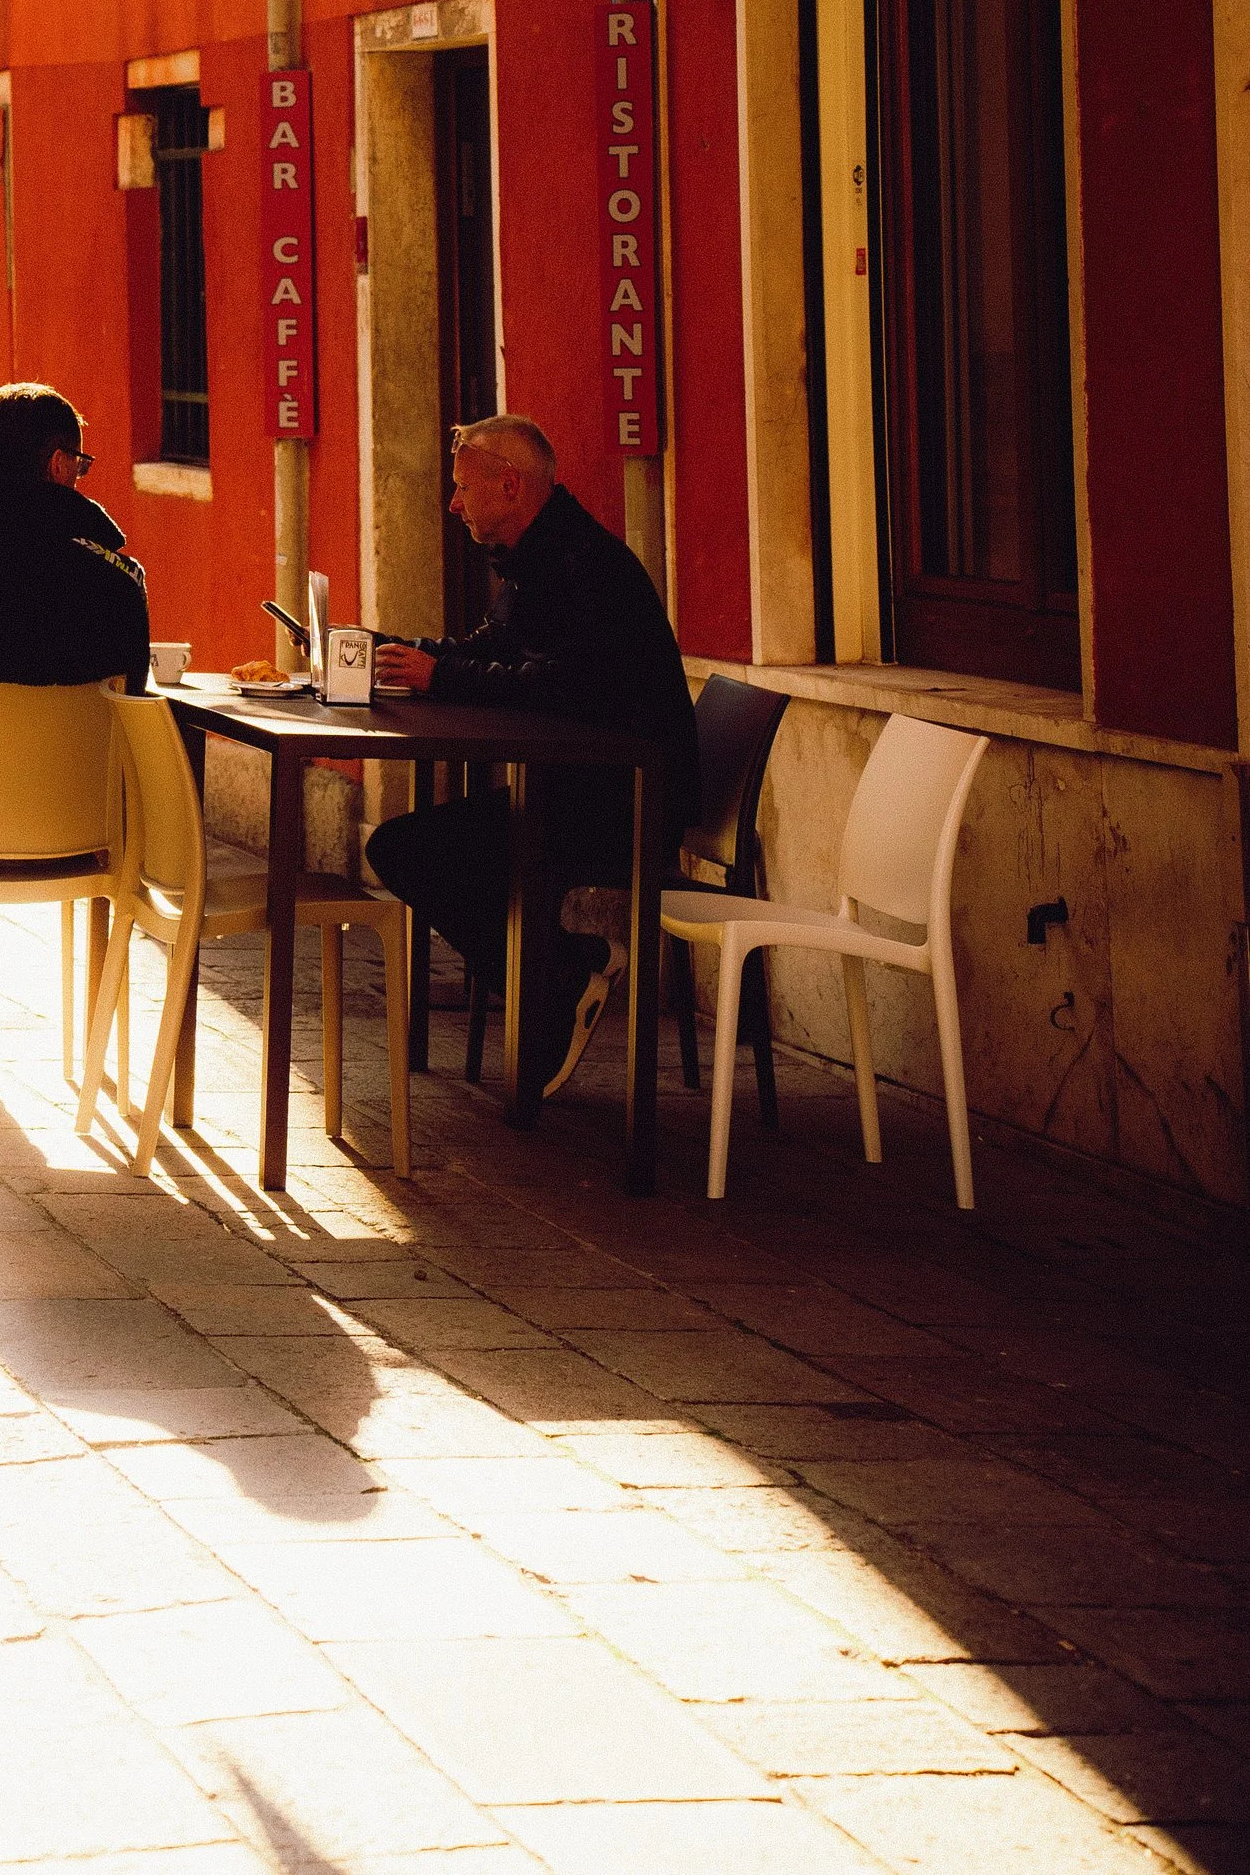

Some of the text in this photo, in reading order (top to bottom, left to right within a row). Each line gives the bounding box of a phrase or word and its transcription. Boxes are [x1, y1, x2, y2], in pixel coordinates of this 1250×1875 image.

[269, 81, 302, 429] BAR CAFFÈ
[607, 13, 643, 445] RISTORANTE
